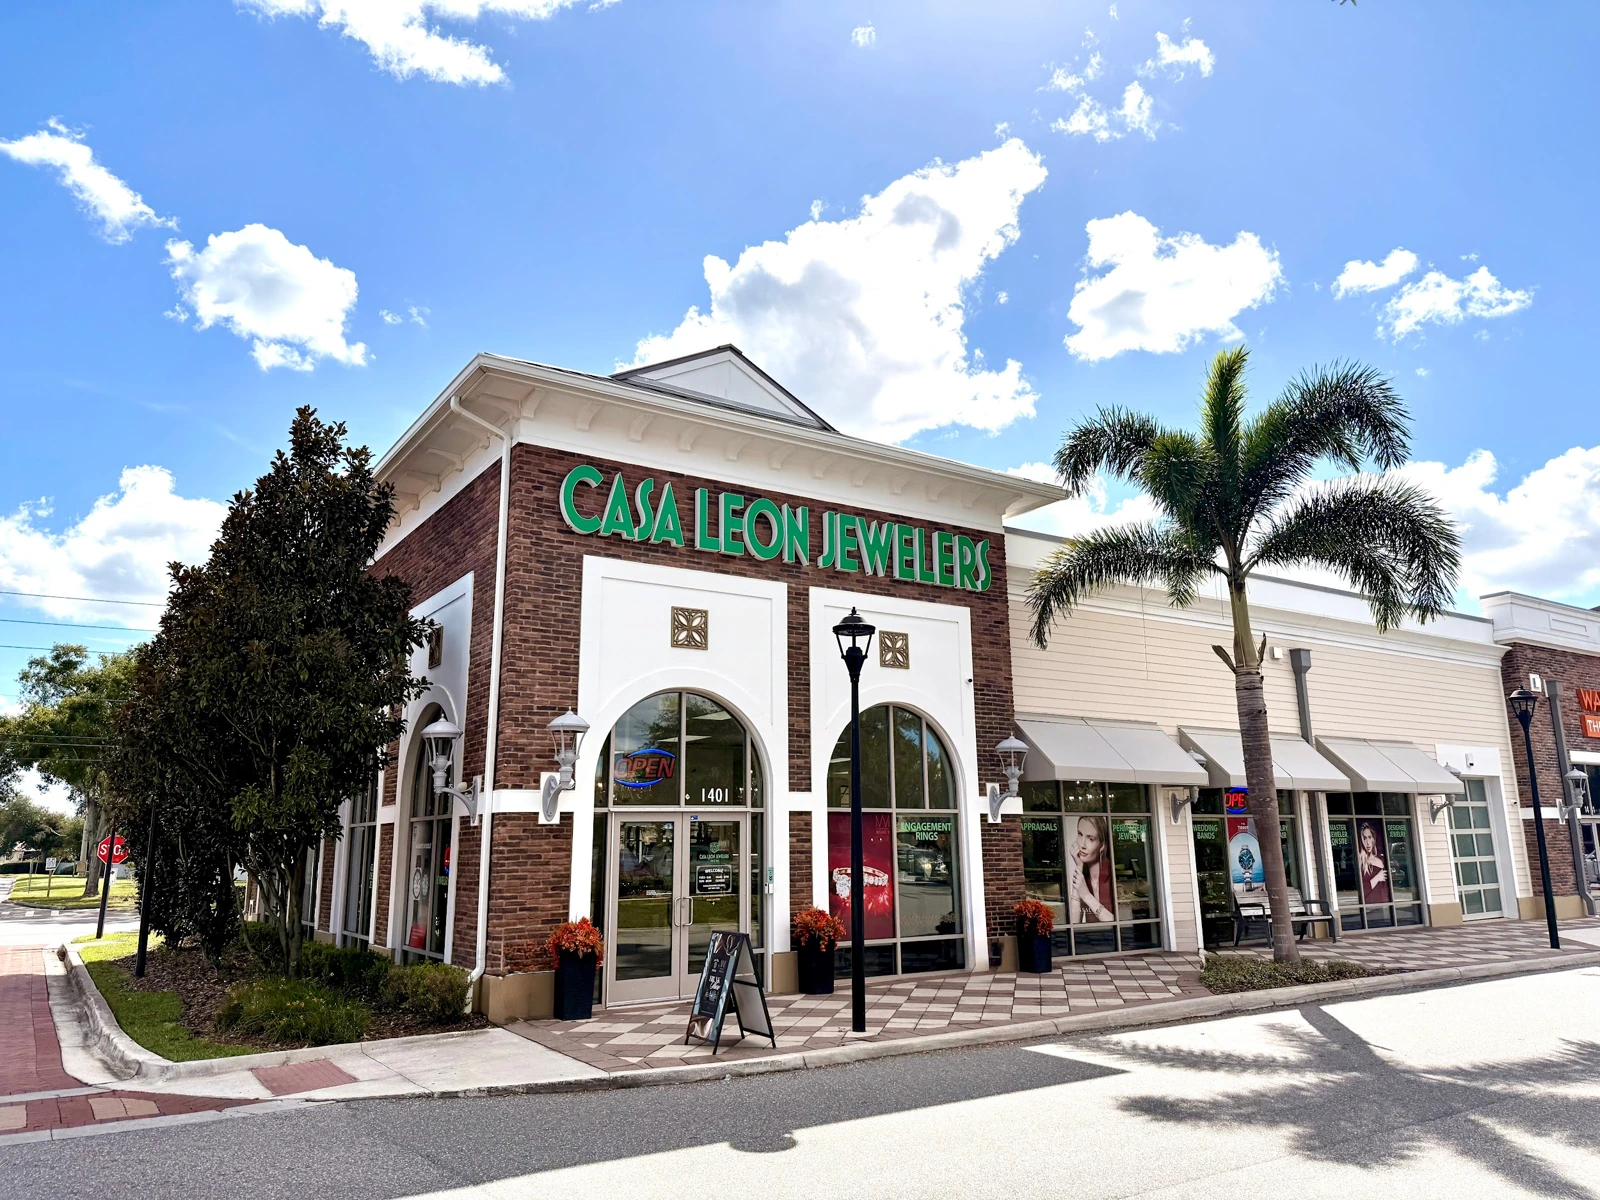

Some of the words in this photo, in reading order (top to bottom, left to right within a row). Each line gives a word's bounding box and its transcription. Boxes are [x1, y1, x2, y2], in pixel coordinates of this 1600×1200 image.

[559, 465, 685, 547] CASA
[695, 487, 810, 566] LEON
[817, 511, 990, 592] JEWELERS
[1586, 719, 1600, 733] TH
[614, 757, 676, 778] OPEN
[701, 787, 729, 802] 1401
[1224, 793, 1246, 807] OPE
[900, 822, 952, 831] ENGAGEMENT
[1020, 822, 1058, 831] APPRAISALS
[1193, 824, 1218, 832] WEDDING
[915, 832, 939, 841] RINGS
[1197, 832, 1216, 840] BANDS
